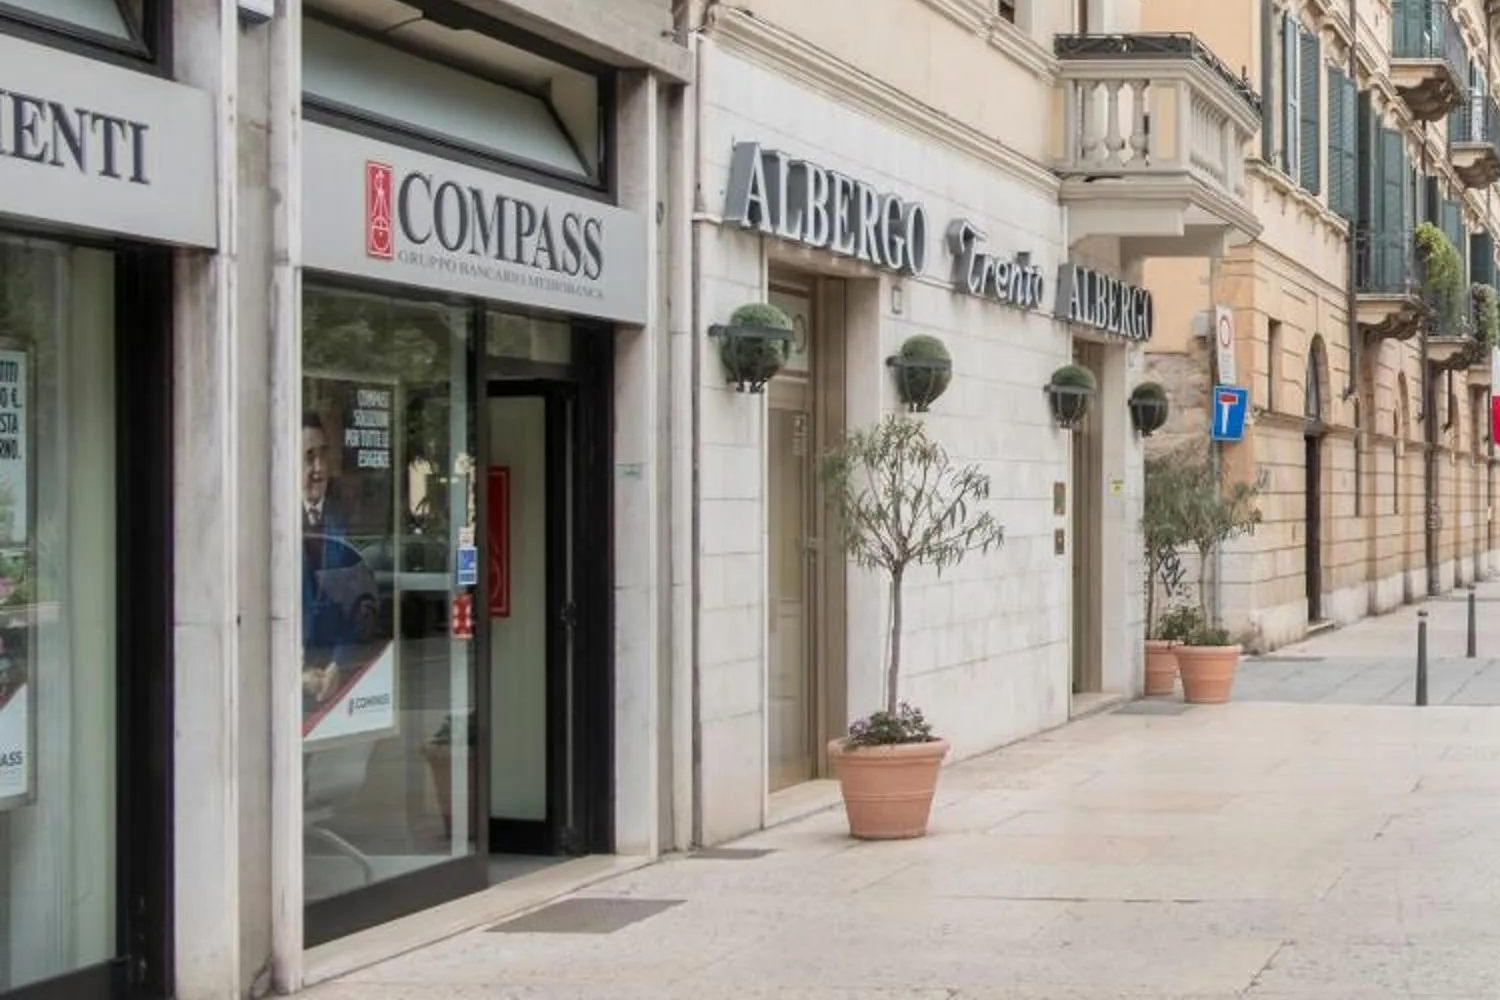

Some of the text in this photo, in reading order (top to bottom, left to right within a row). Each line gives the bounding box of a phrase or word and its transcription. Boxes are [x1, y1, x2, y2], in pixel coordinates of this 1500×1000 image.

[0, 88, 150, 185] ENTI
[398, 172, 604, 281] COMPASS
[737, 142, 928, 277] ALBERGO
[957, 219, 1044, 307] Trento
[1068, 263, 1154, 341] ALBERGO
